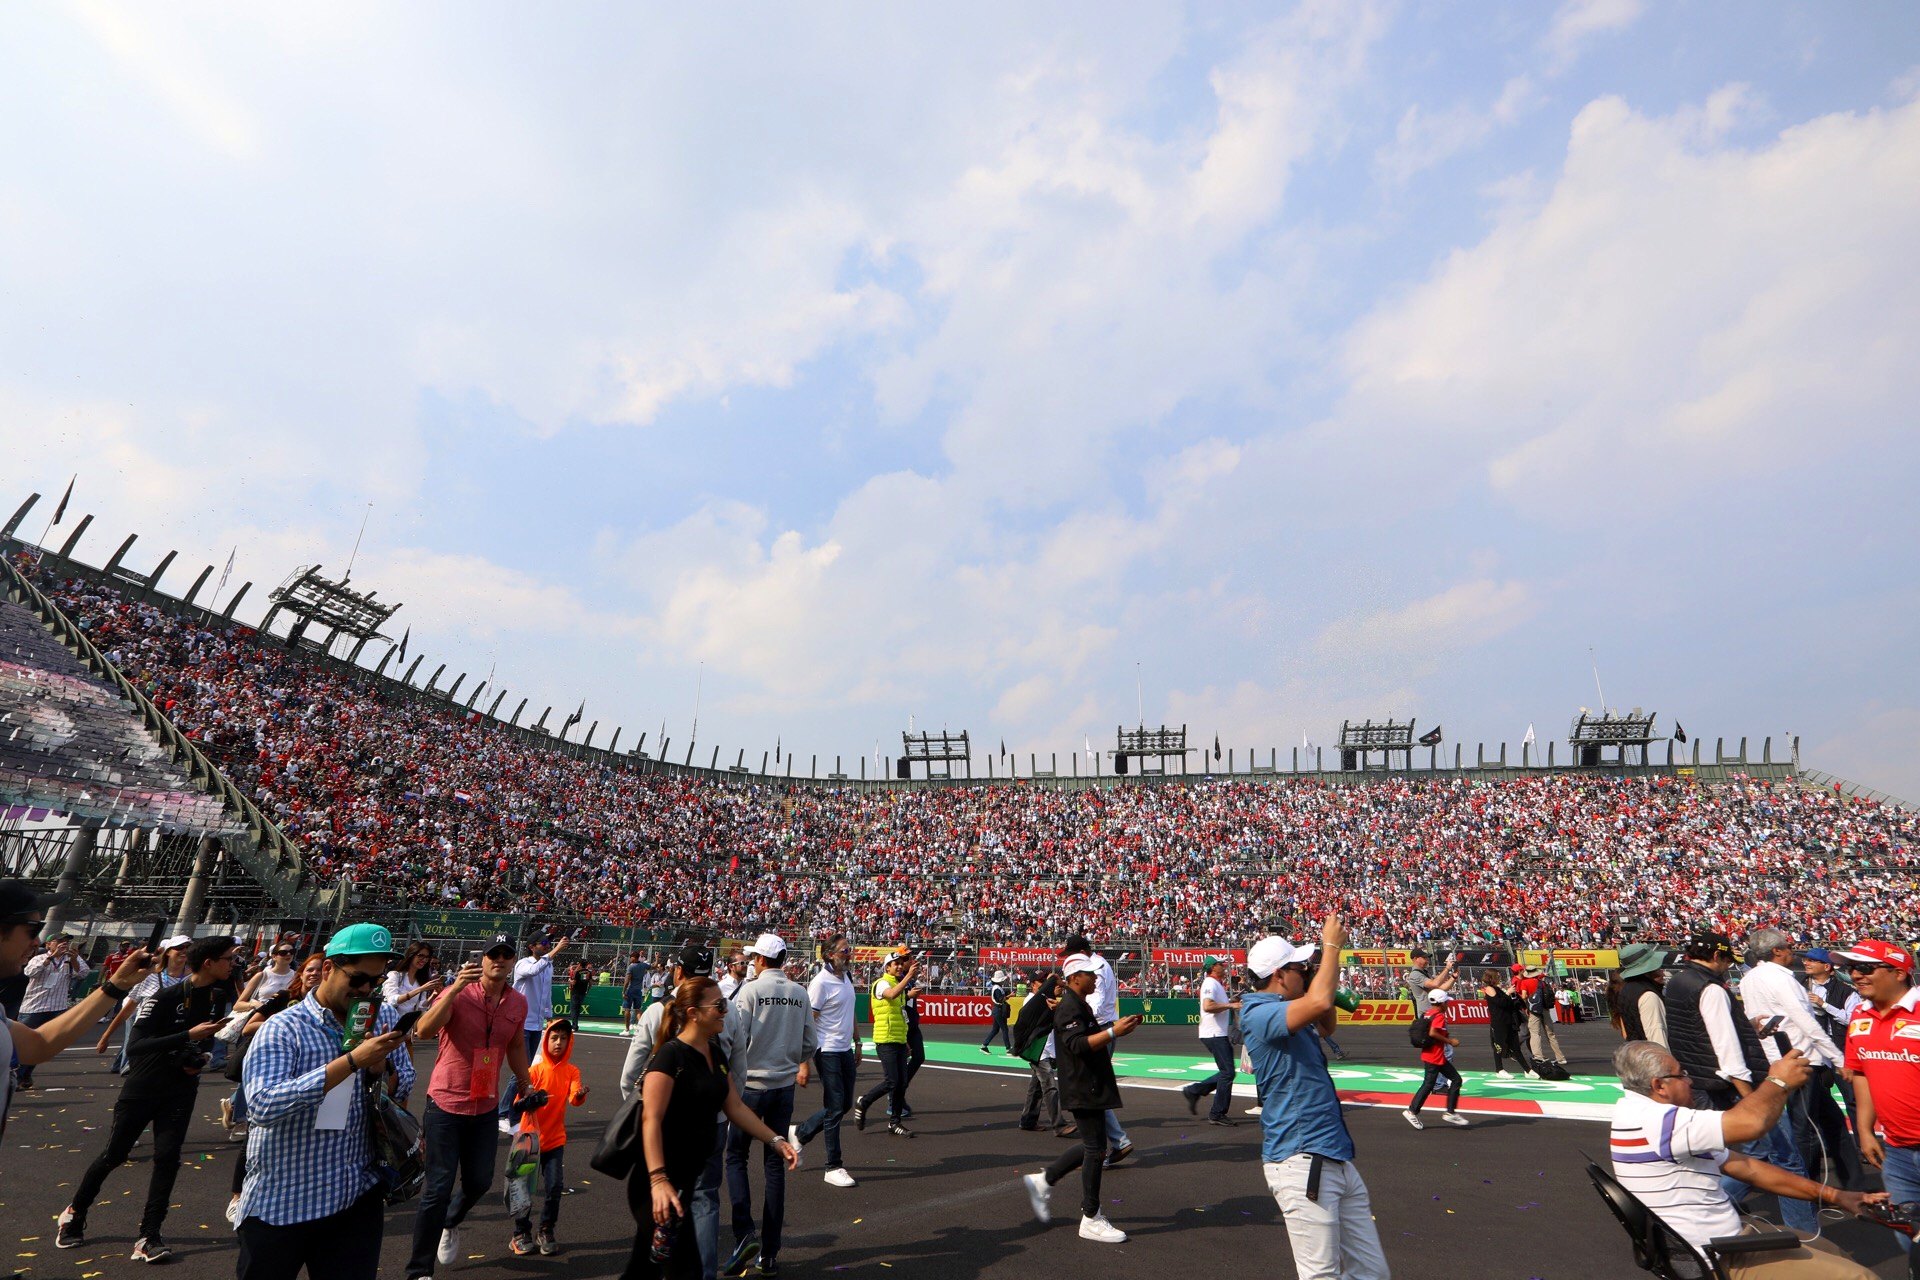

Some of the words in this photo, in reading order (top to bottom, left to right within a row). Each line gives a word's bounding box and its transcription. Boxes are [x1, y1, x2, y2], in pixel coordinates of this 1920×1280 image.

[990, 951, 1008, 963] Fly
[1011, 951, 1058, 962] Emirates
[1163, 952, 1182, 964] Fly
[1541, 953, 1596, 966] PELLI
[758, 998, 802, 1008] PETRONAS
[551, 1005, 590, 1015] OLX
[1351, 1004, 1415, 1020] DHL
[1457, 1003, 1489, 1018] Emir
[1857, 1046, 1920, 1063] Santande
